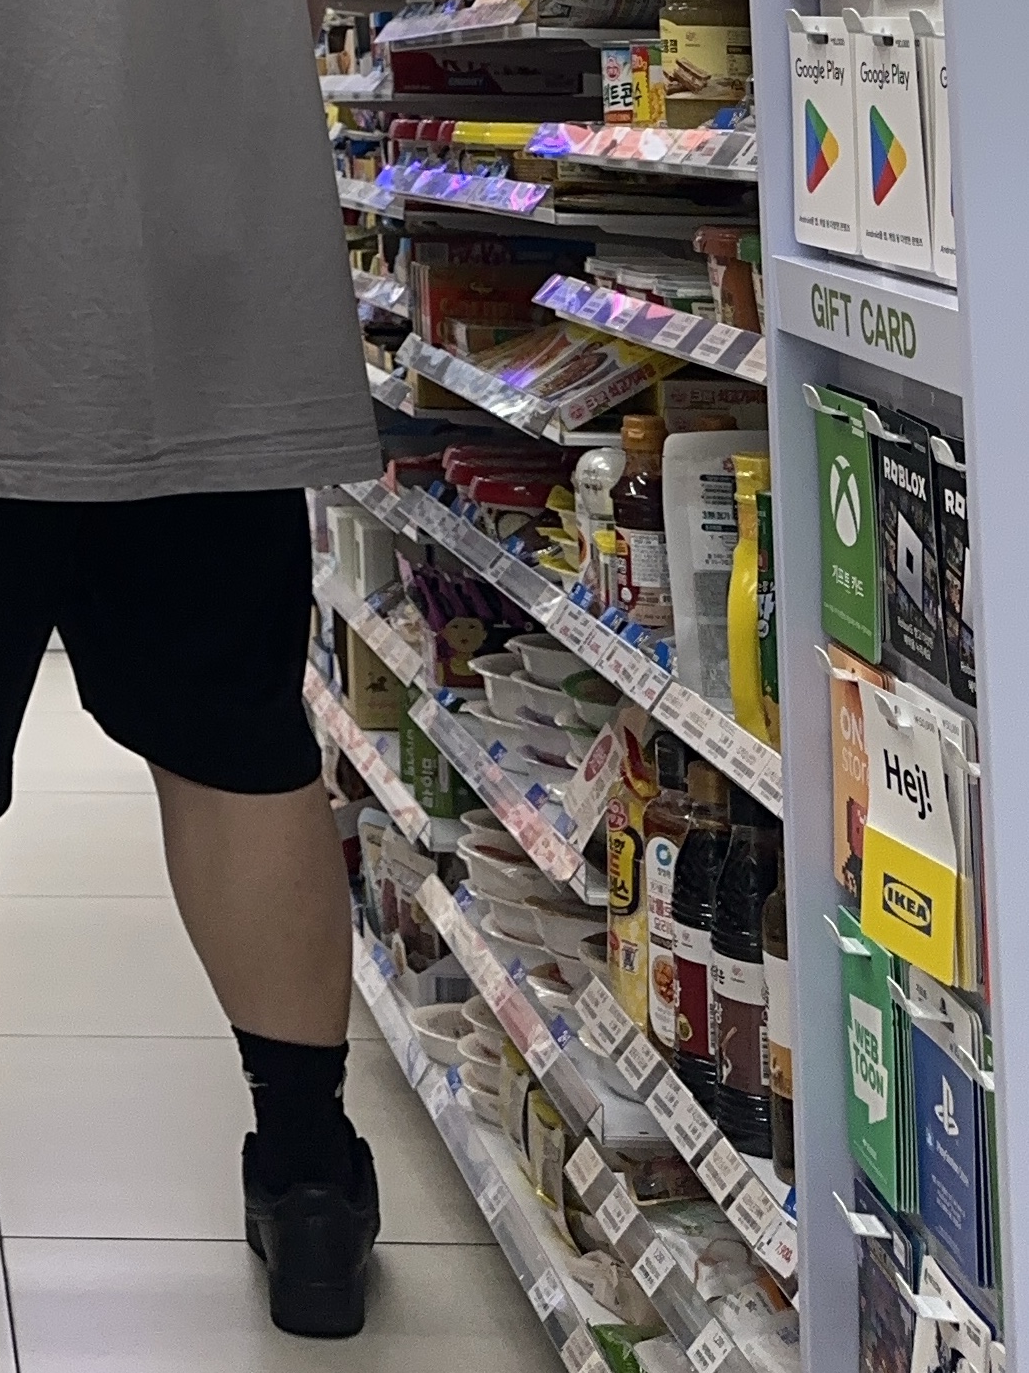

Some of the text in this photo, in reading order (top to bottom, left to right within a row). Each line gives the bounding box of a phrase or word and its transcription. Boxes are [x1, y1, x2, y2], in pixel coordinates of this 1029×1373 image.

[795, 58, 846, 86] Google Play
[860, 62, 910, 90] Google Play
[812, 283, 916, 359] GIFT CARD
[883, 455, 927, 502] ROBLOX
[831, 564, 865, 597] 기프트 카드
[883, 749, 933, 820] Hej!
[887, 886, 928, 922] IKEA
[853, 1019, 878, 1065] WEB
[853, 1043, 884, 1099] TOON
